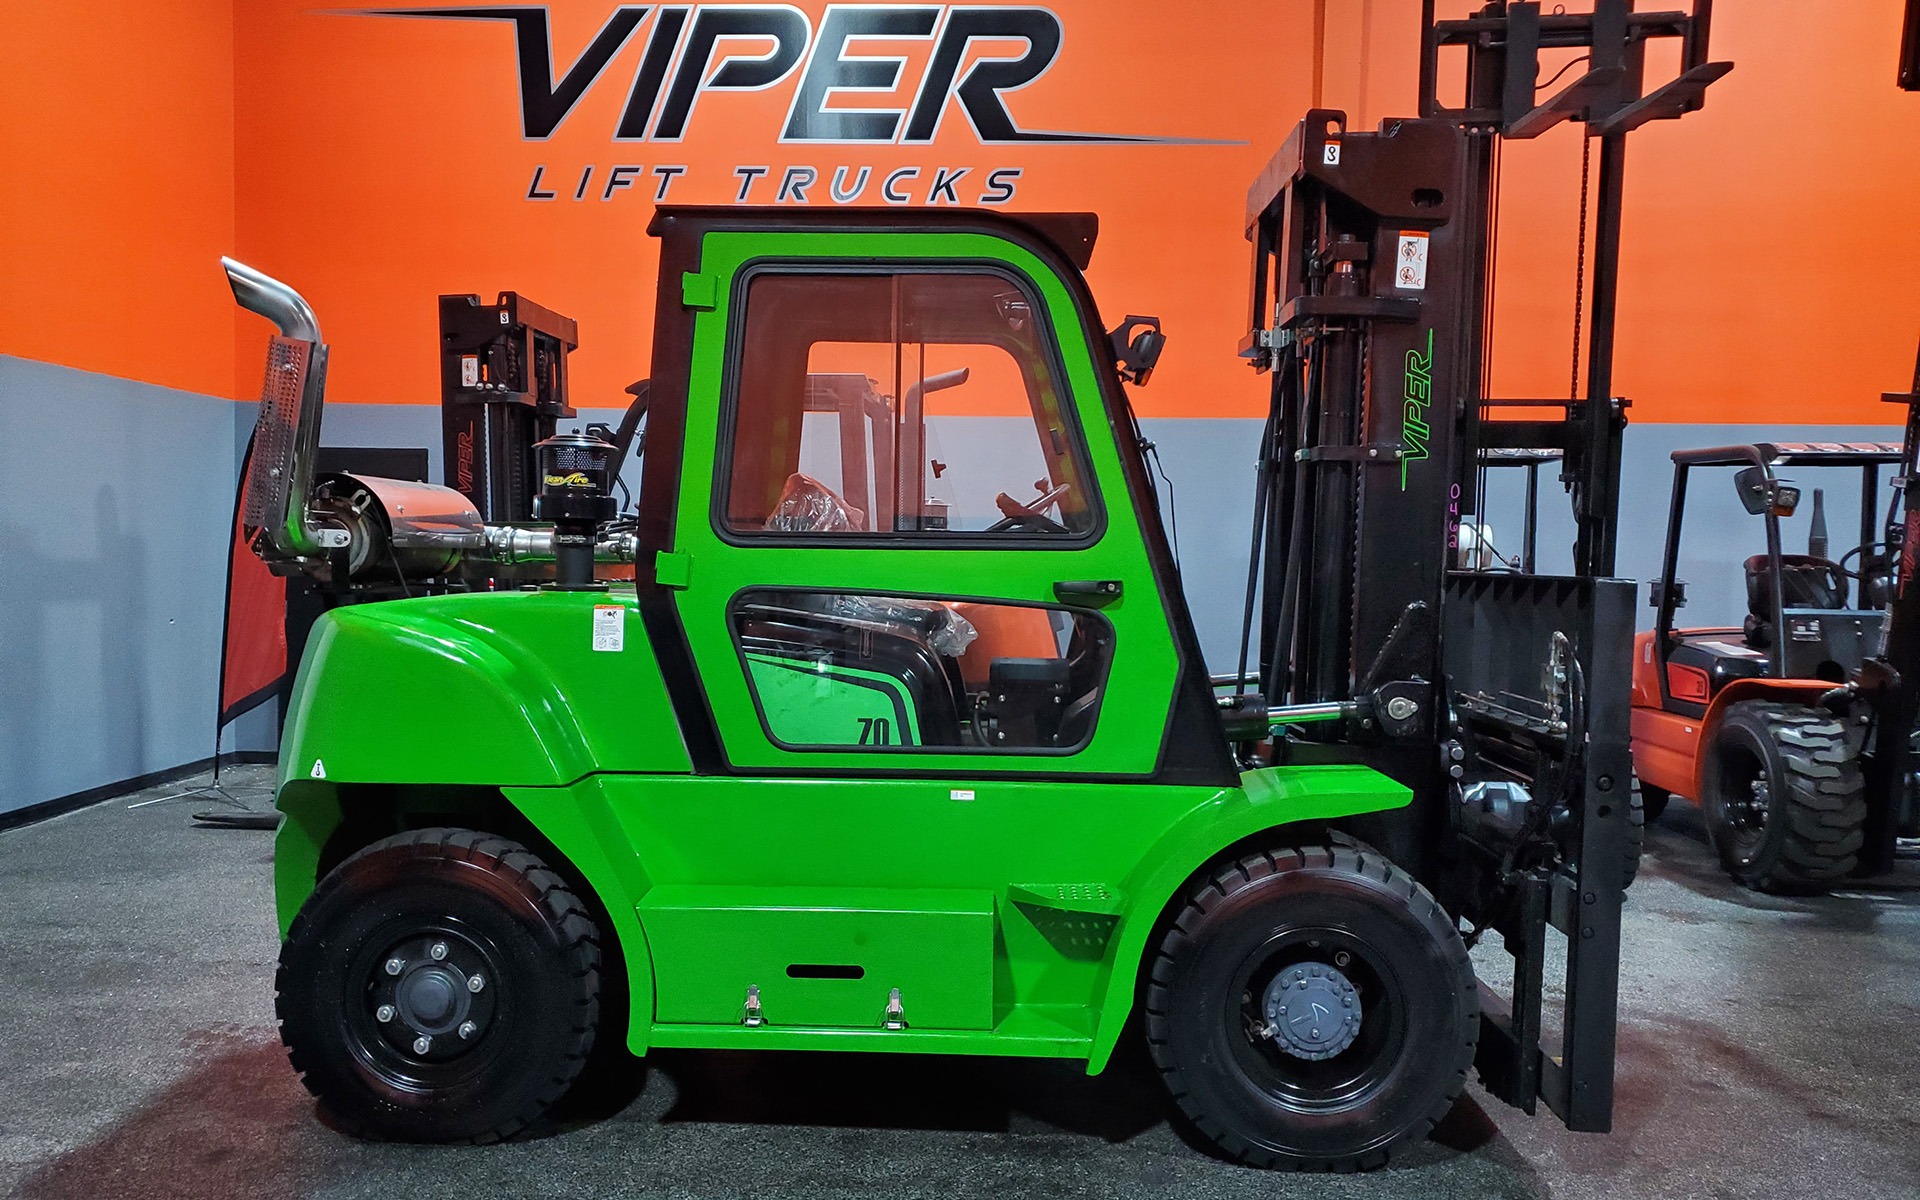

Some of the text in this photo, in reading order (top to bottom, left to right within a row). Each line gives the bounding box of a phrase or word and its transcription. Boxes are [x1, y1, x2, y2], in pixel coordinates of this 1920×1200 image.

[500, 3, 1072, 146] VIPER
[524, 164, 1025, 205] LIFT TRUCKS
[1402, 340, 1433, 474] VIPER
[457, 426, 475, 494] VIPER
[857, 717, 890, 746] 70
